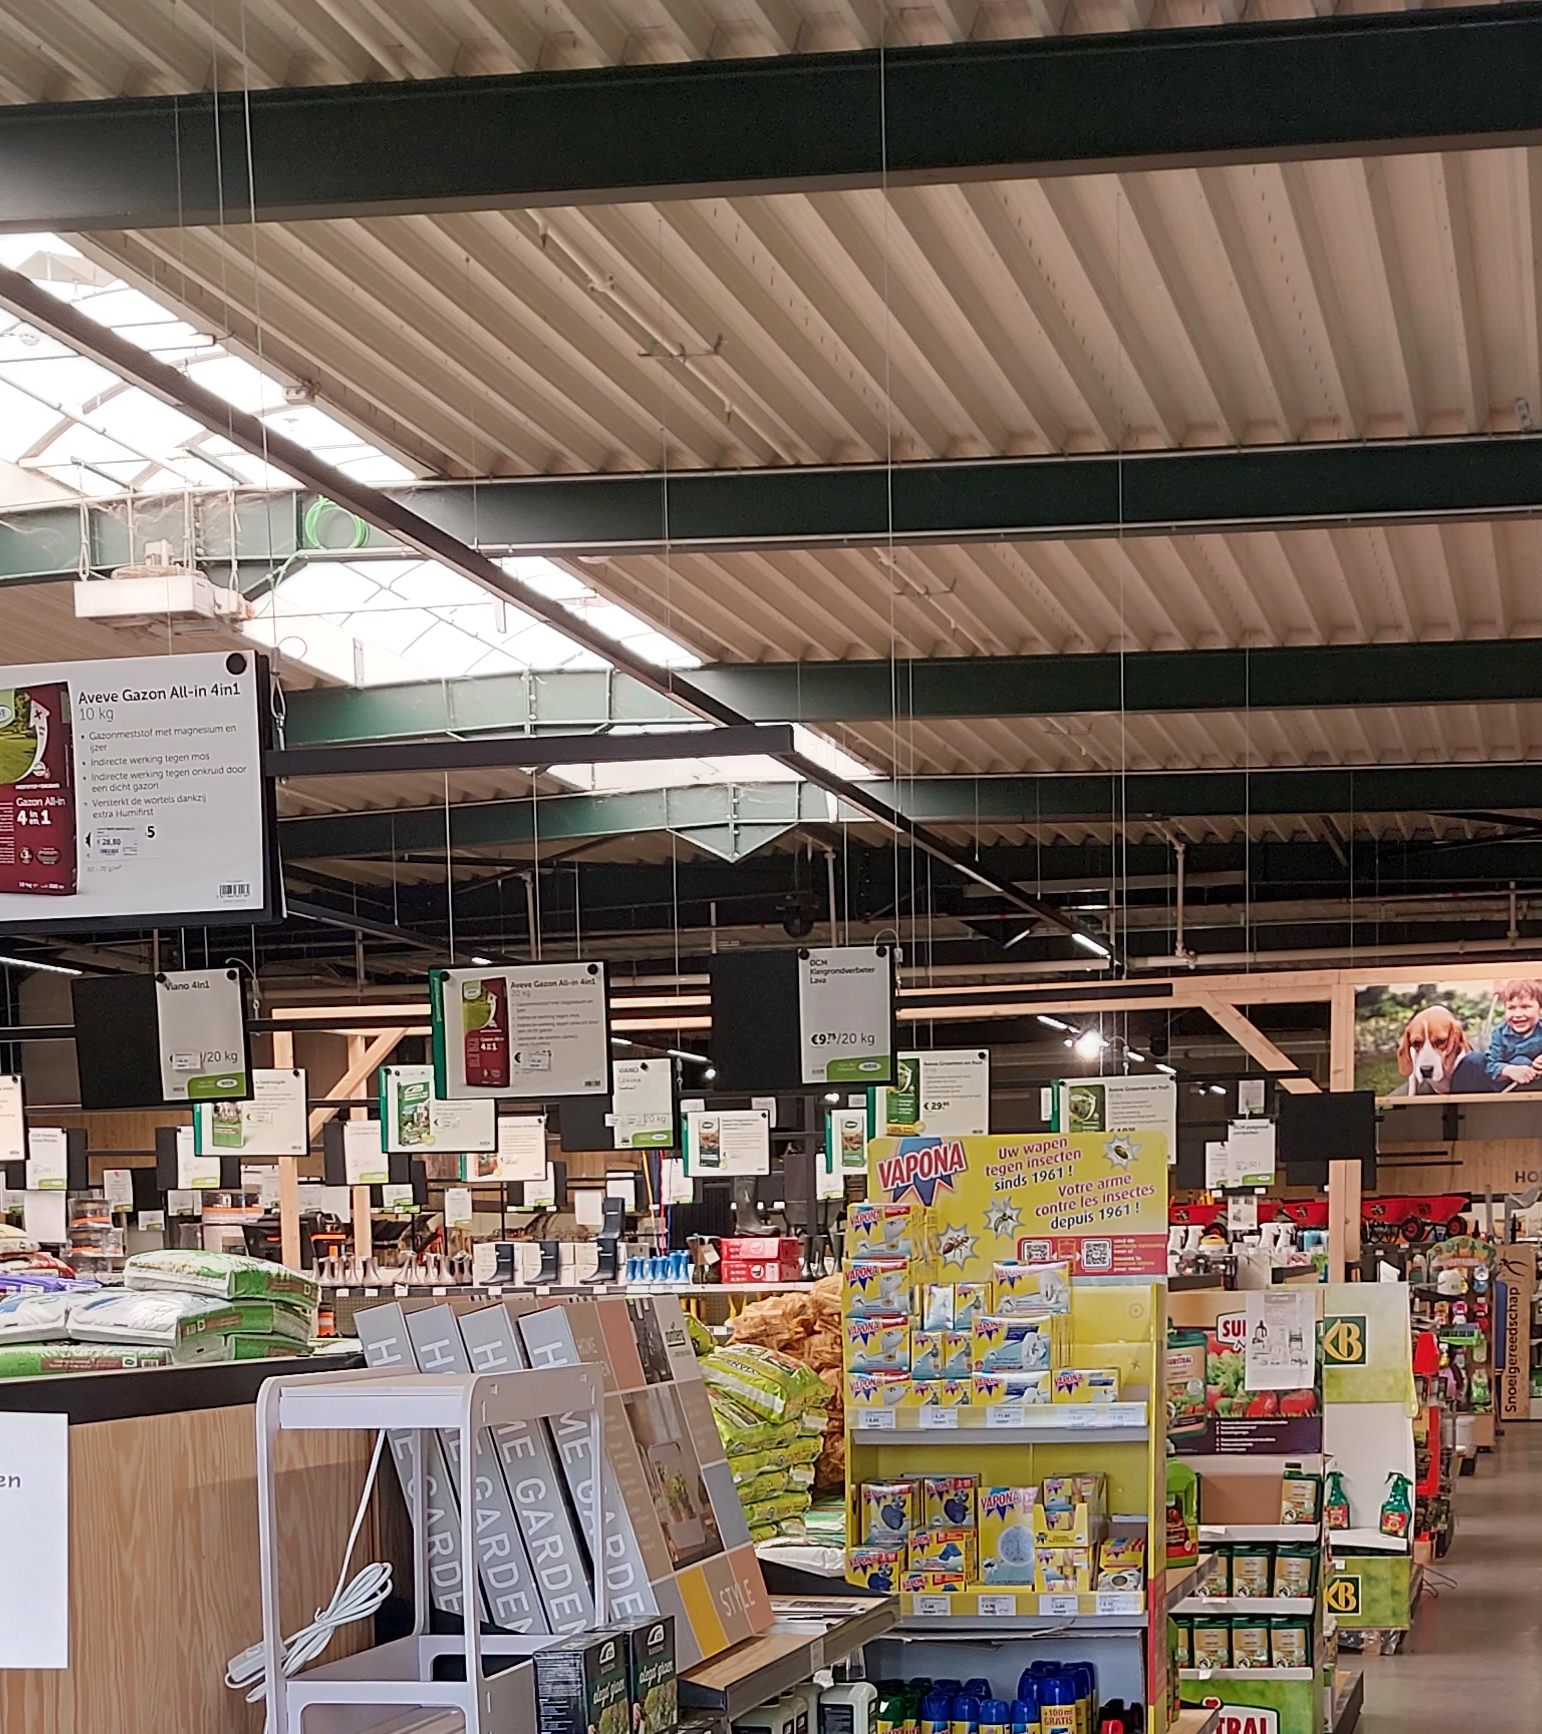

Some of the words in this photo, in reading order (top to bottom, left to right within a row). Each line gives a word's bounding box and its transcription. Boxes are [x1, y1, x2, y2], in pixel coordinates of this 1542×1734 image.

[79, 692, 118, 705] Aveve
[123, 688, 166, 702] Gazon
[170, 685, 207, 699] All-in
[211, 683, 241, 696] 4in1
[79, 708, 95, 721] 10
[99, 707, 114, 722] kg
[89, 729, 153, 740] Gazonmeststof
[155, 728, 172, 737] met
[174, 726, 223, 736] magnesium
[91, 757, 127, 766] Indirecte
[130, 755, 162, 766] werking
[165, 754, 189, 764] tegen
[92, 771, 128, 781] Indirecte
[131, 770, 163, 780] werking
[166, 768, 189, 778] tegen
[192, 767, 224, 776] onkruid
[226, 766, 246, 774] door
[92, 785, 107, 793] een
[110, 783, 131, 791] dicht
[133, 782, 159, 792] gazon
[93, 811, 113, 819] extra
[116, 809, 154, 817] Humifirst
[999, 1148, 1018, 1160] Uw
[1023, 1138, 1067, 1157] wapen
[878, 1142, 964, 1190] VAPONA
[985, 1161, 1023, 1178] tegen
[1026, 1150, 1081, 1168] insecten
[994, 1172, 1027, 1191] sinds
[1031, 1166, 1064, 1185] 1961
[1059, 1183, 1093, 1196] Votre
[1097, 1176, 1131, 1190] arme
[1035, 1202, 1076, 1216] contre
[1081, 1195, 1099, 1208] les
[1103, 1186, 1155, 1204] insectes
[1051, 1214, 1094, 1230] depuis
[1099, 1206, 1131, 1220] 1961
[1505, 1286, 1518, 1413] Snoeigereedschap
[720, 1579, 755, 1617] STYLE
